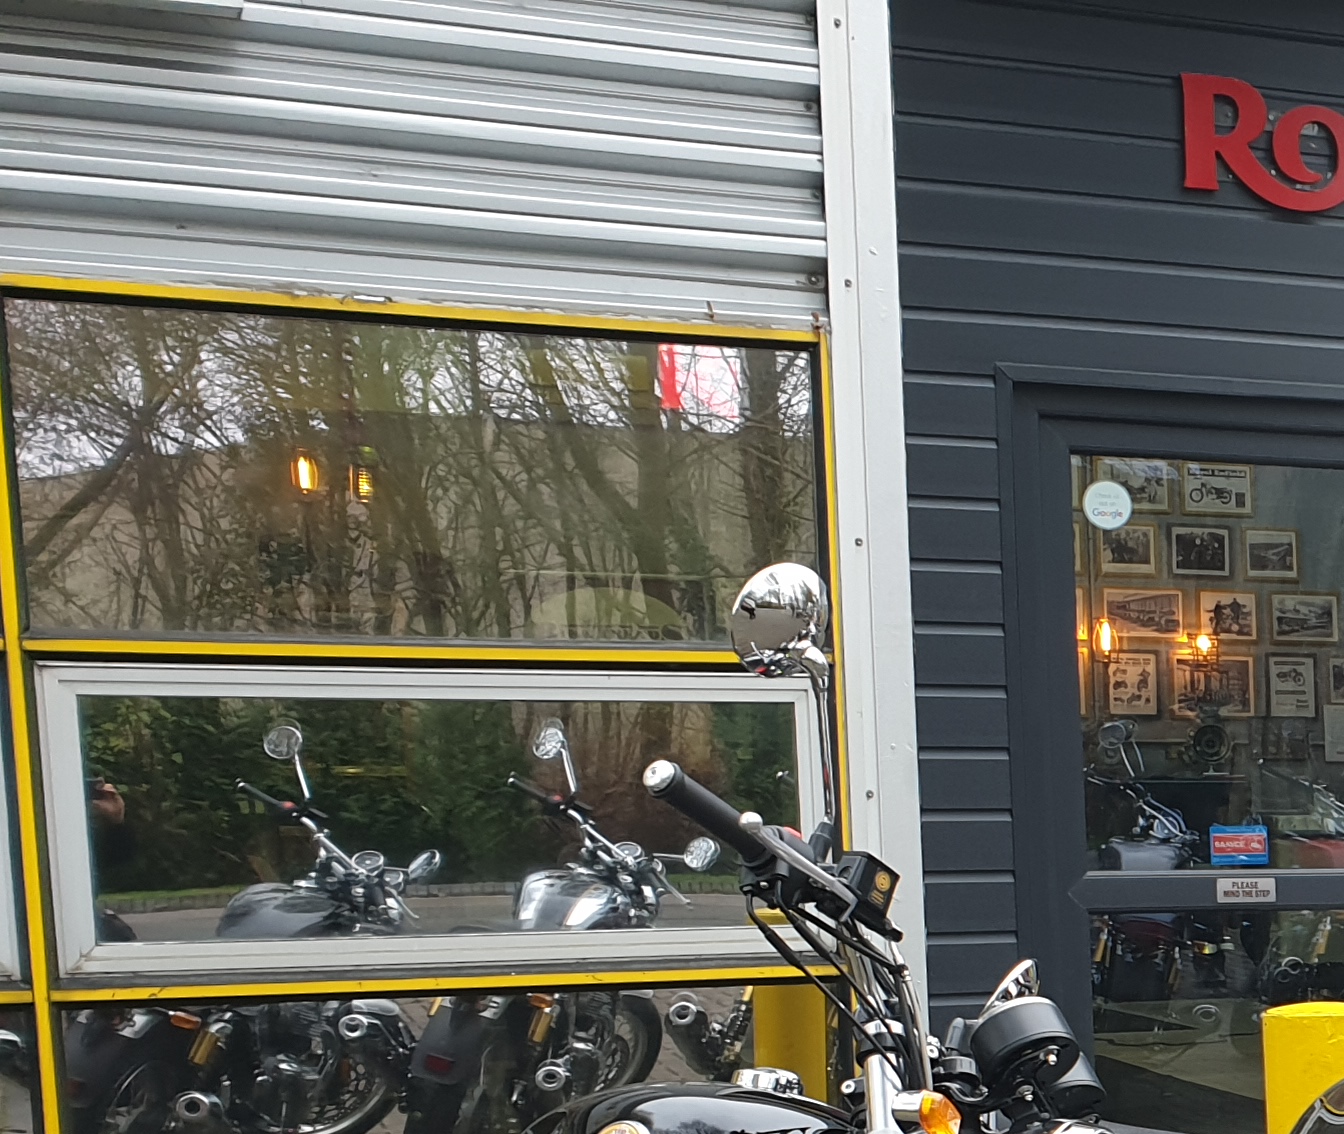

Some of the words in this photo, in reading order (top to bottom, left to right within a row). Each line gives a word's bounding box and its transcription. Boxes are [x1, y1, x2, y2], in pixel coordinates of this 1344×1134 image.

[1092, 507, 1124, 520] Google
[1232, 881, 1259, 889] PLEASE
[1223, 890, 1240, 898] MIND
[1242, 890, 1253, 898] THE
[1255, 890, 1271, 898] STEP
